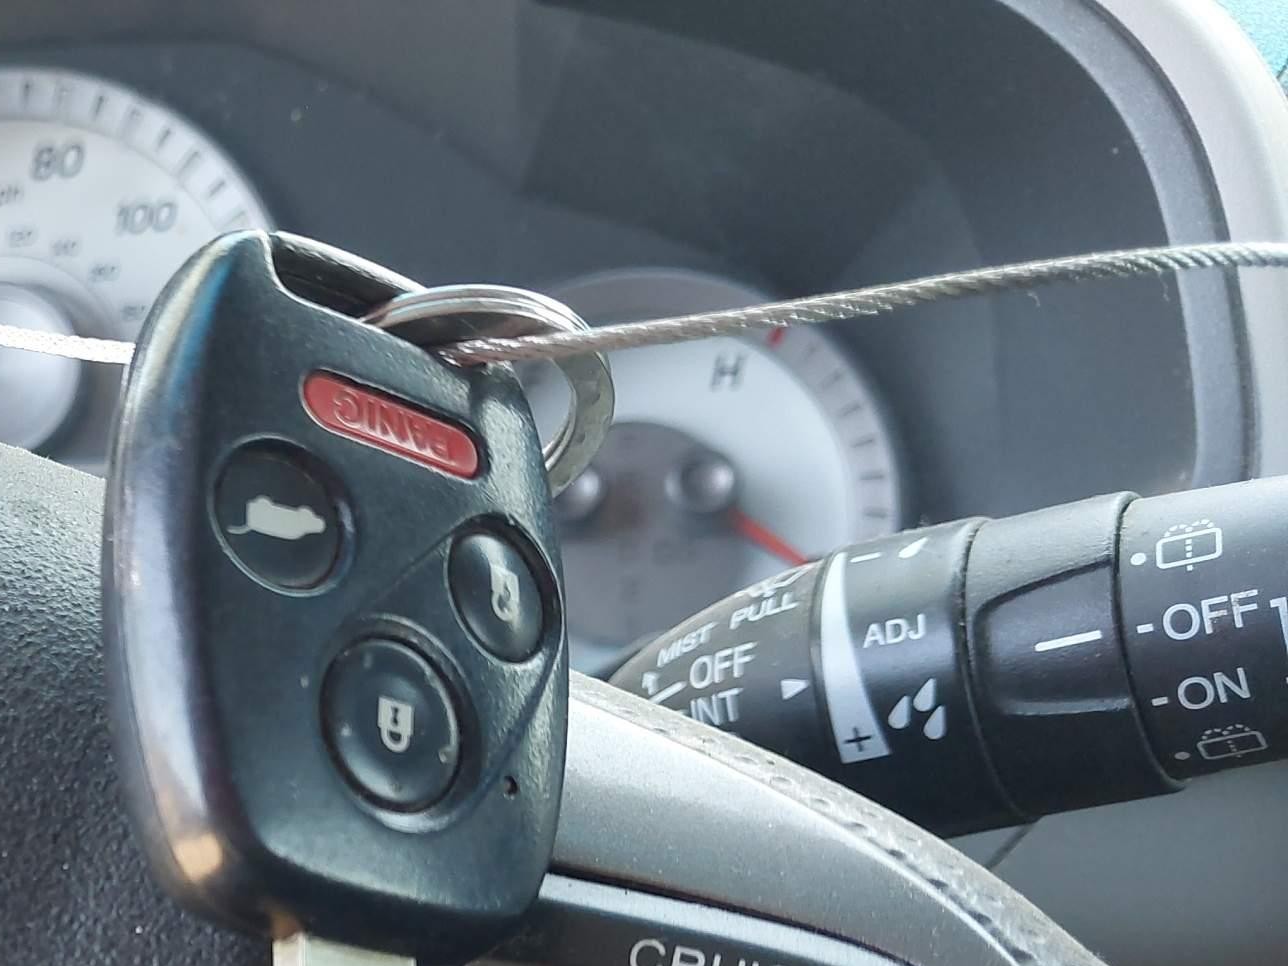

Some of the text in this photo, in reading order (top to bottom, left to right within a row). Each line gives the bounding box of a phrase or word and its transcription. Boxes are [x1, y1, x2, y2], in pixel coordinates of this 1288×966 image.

[30, 143, 85, 182] 80
[116, 200, 178, 234] 100
[711, 353, 746, 392] H
[656, 592, 800, 668] MIST PULL
[862, 613, 926, 650] ADJ
[1163, 588, 1259, 641] OFF
[688, 641, 758, 690] OFF
[689, 687, 744, 726] INT
[1177, 667, 1252, 710] ON
